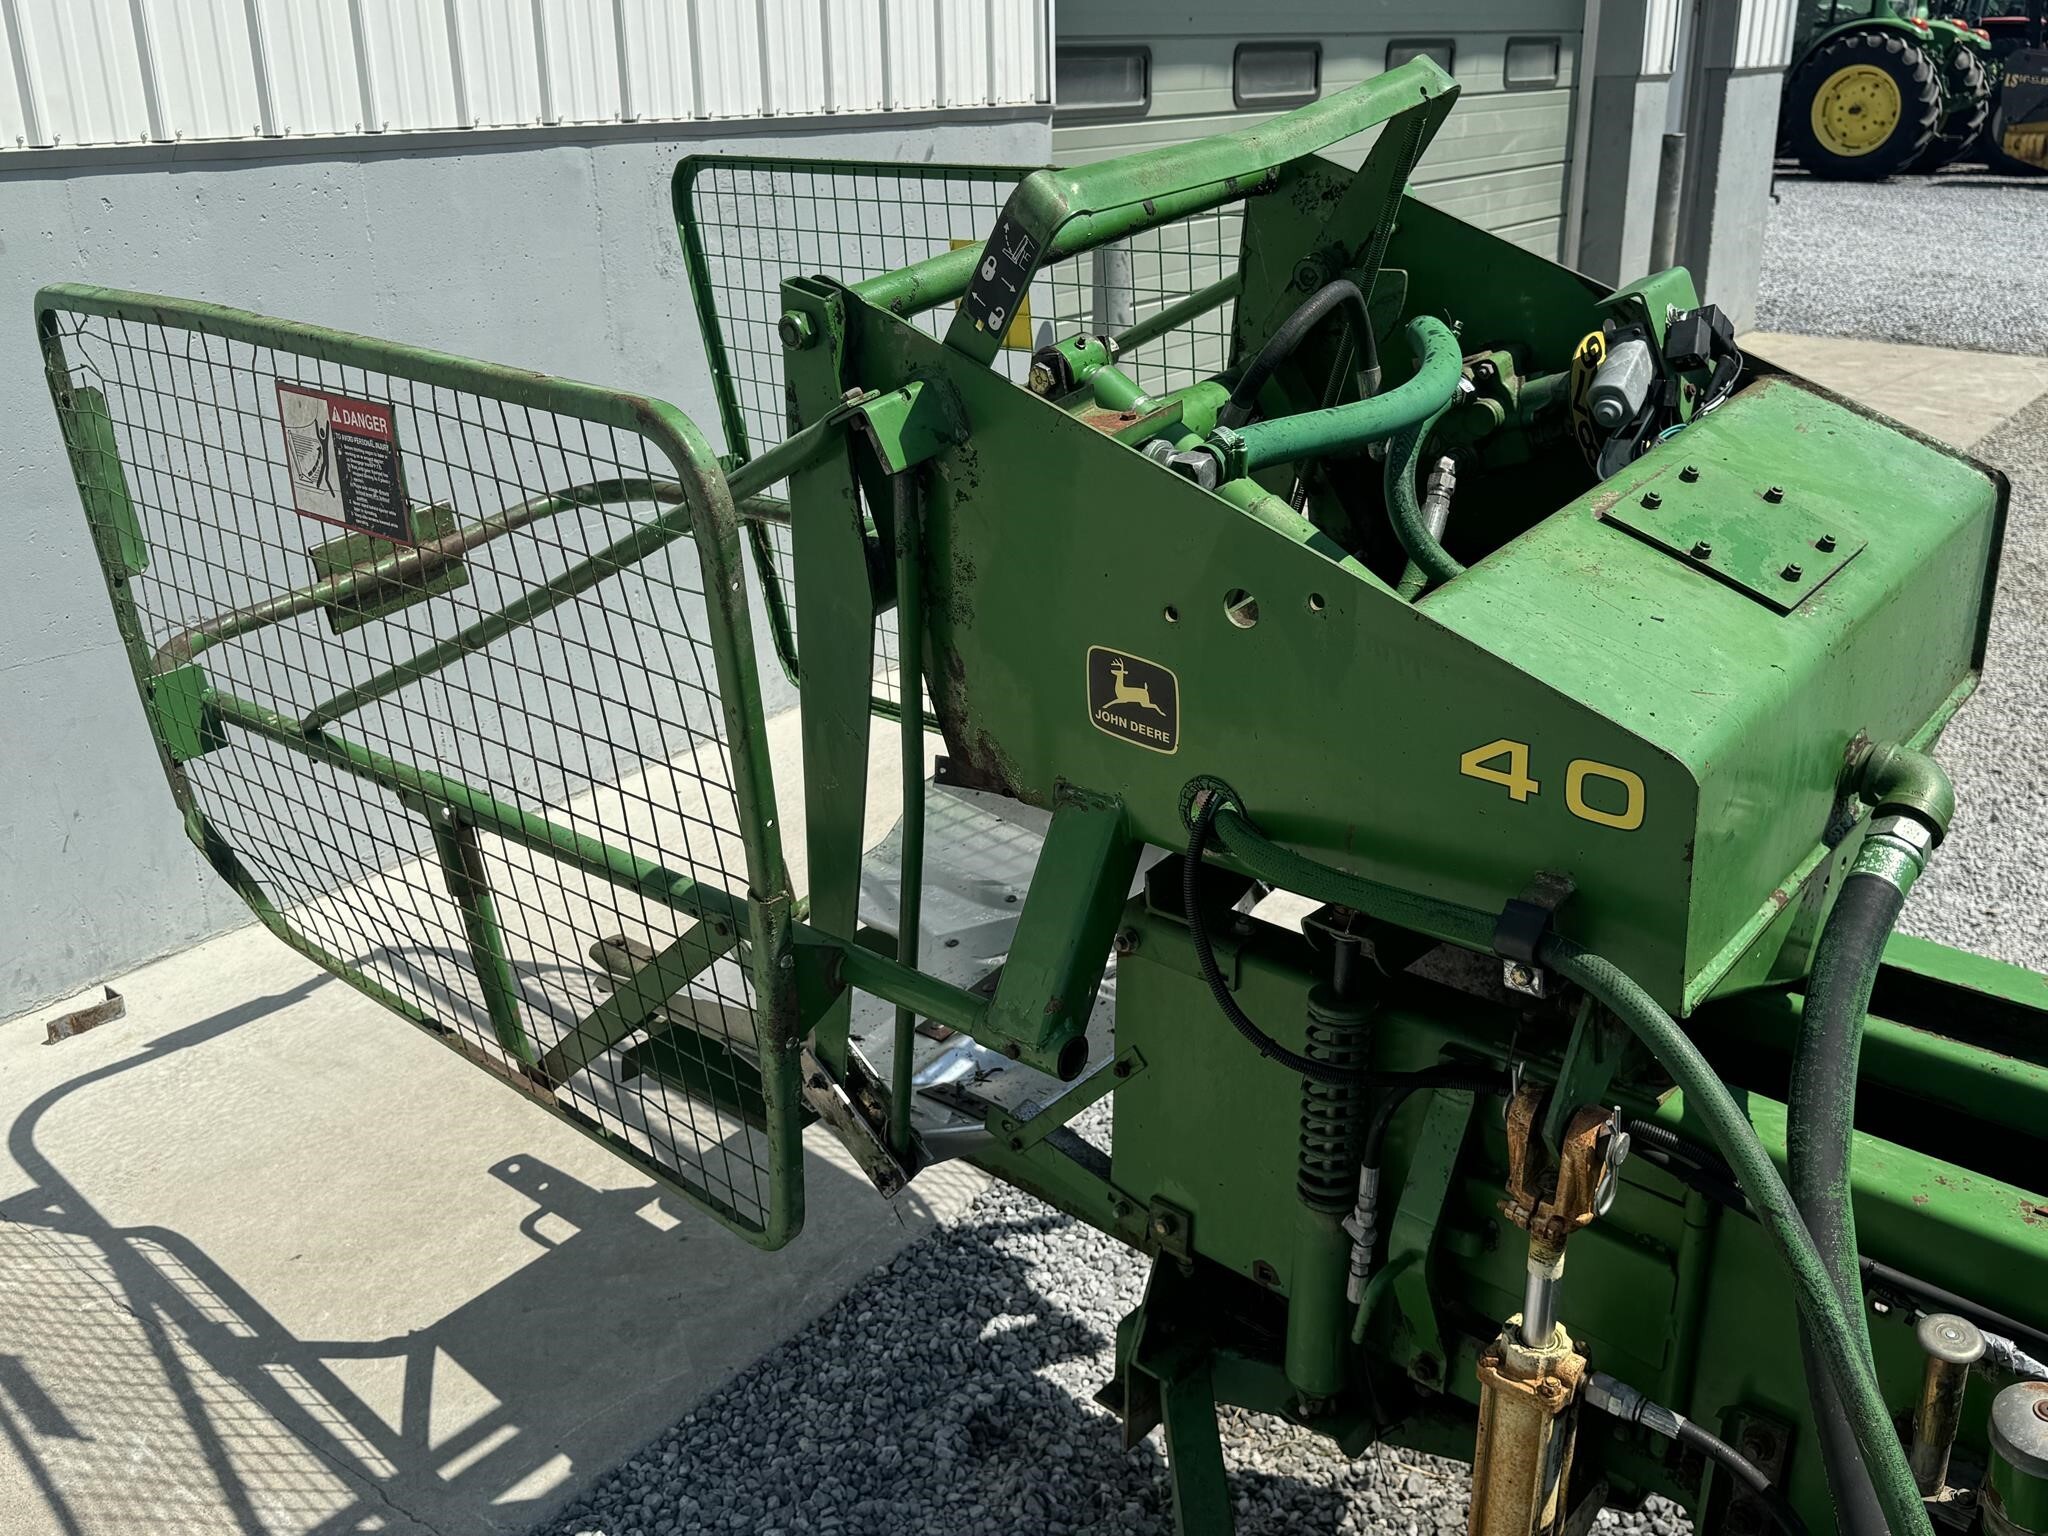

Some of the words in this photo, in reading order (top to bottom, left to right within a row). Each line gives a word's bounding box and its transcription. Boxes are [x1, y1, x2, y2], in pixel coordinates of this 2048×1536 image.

[342, 409, 388, 434] DANGER
[1095, 709, 1127, 728] JOHN
[1130, 720, 1170, 743] DEERE
